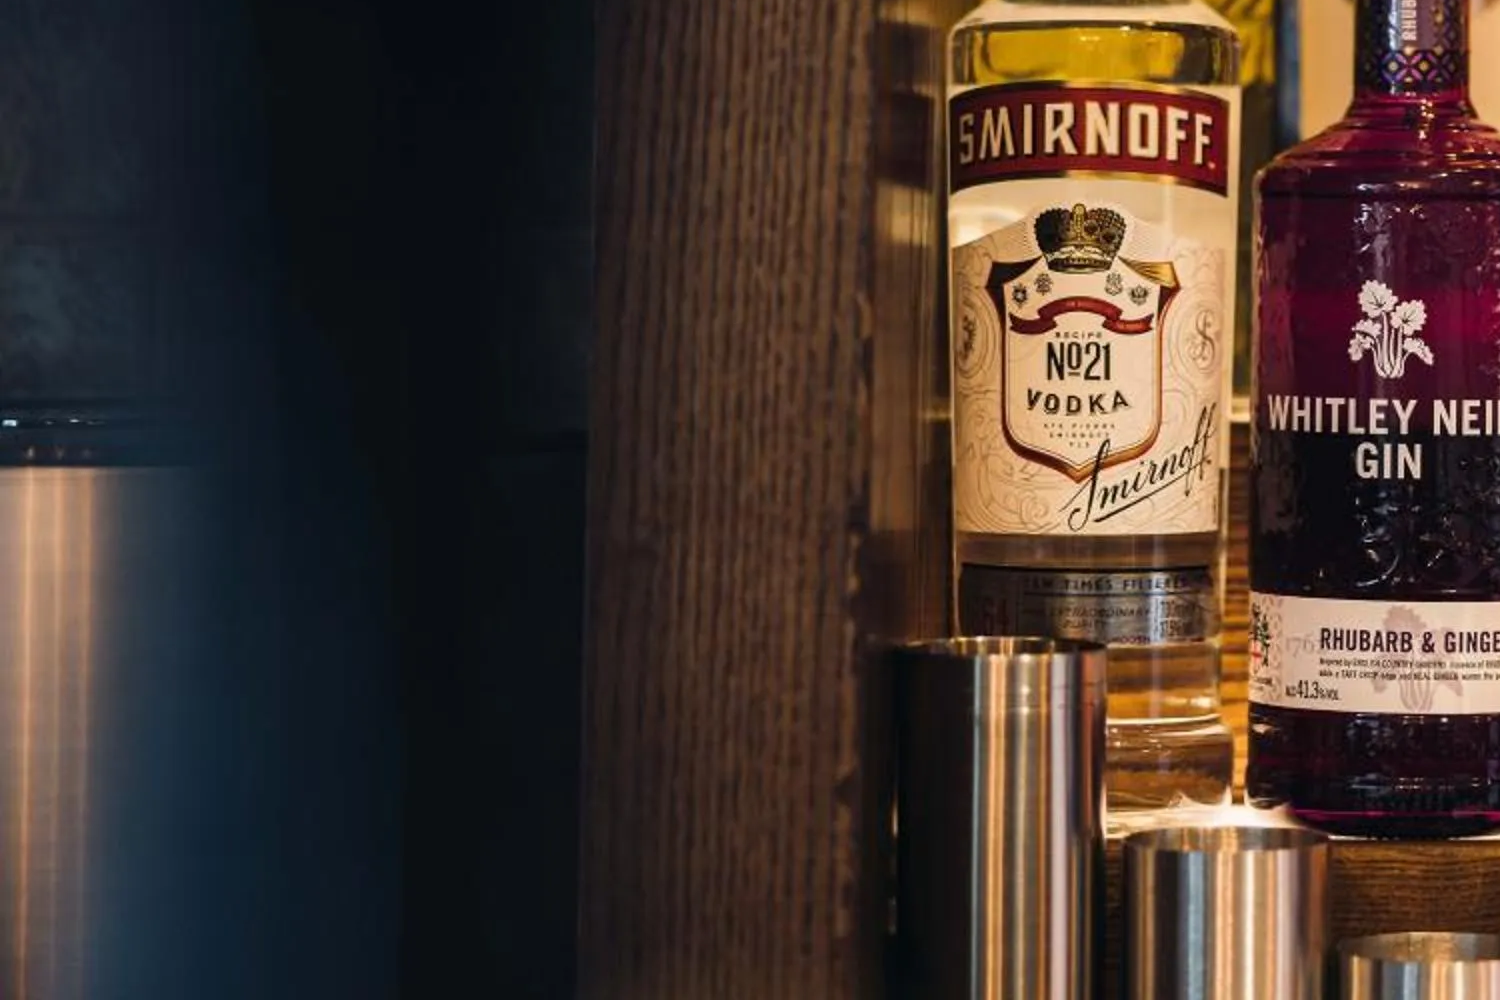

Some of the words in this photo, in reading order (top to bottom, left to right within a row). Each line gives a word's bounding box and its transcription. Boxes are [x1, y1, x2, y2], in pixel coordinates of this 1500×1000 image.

[958, 101, 1213, 165] SMIRNOFF
[1027, 388, 1130, 416] VODKA
[1268, 395, 1417, 435] WHITLEY
[1067, 402, 1217, 532] Smirnoff
[1355, 442, 1423, 479] GIN
[1320, 627, 1413, 652] RHUBARB
[1421, 631, 1436, 653] &
